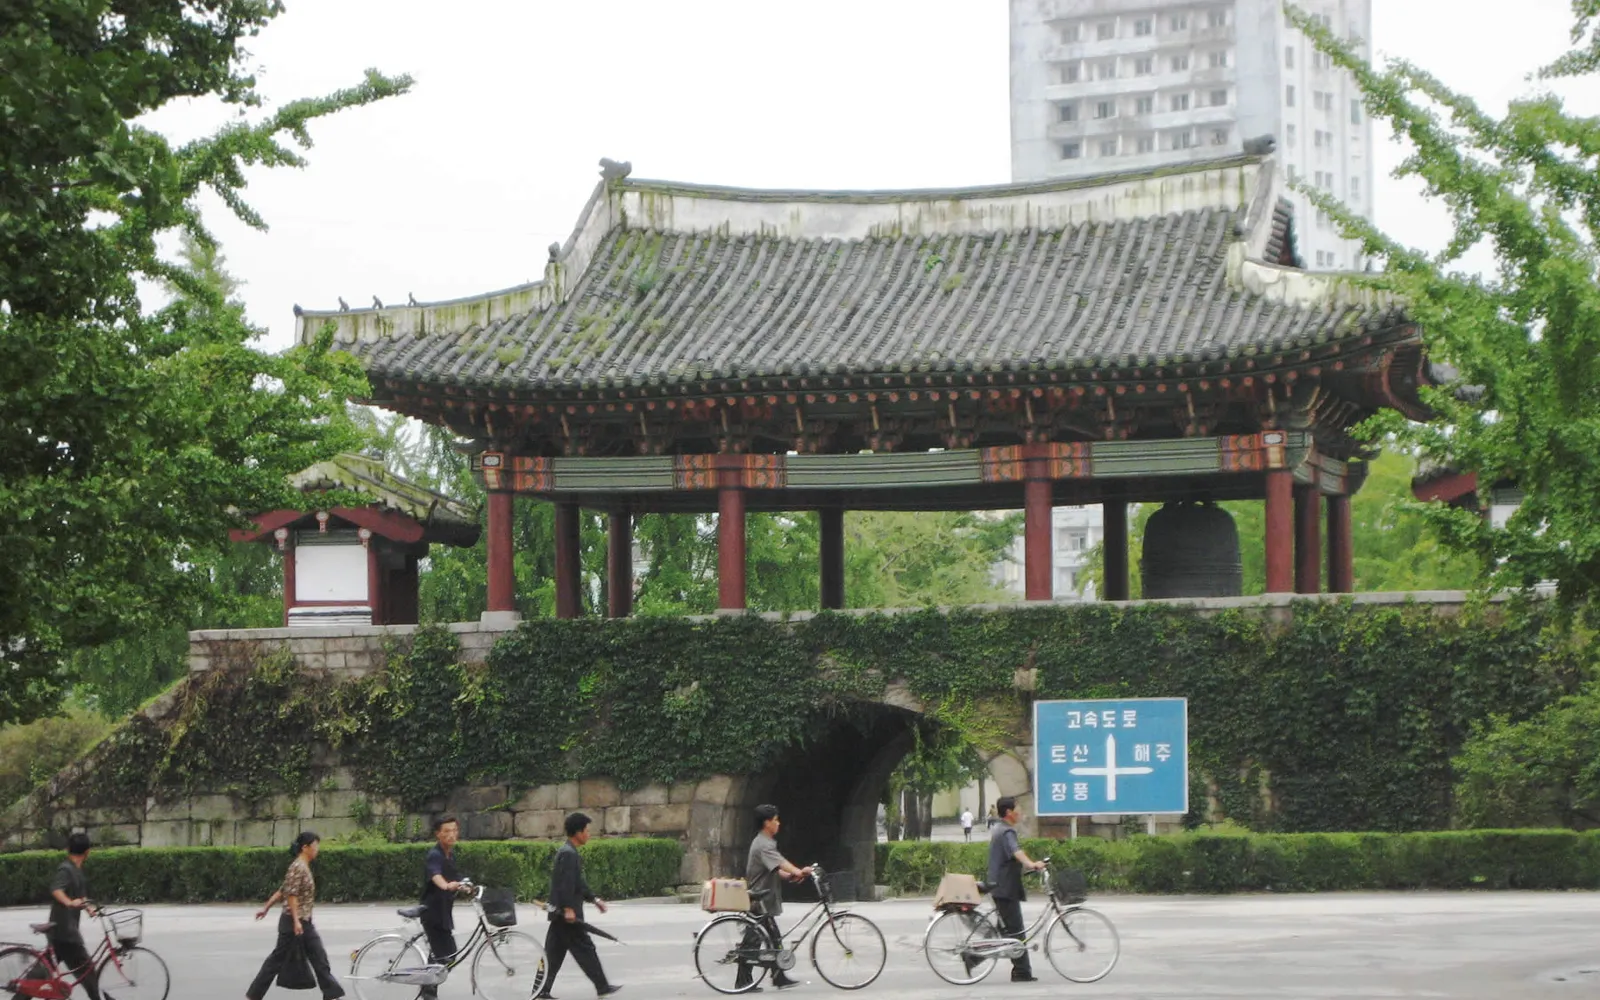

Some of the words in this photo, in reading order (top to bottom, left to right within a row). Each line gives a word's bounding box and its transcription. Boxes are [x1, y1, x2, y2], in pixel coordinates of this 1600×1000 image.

[1067, 710, 1137, 729] 고속도로
[1052, 744, 1089, 763] 토산
[1134, 744, 1171, 762] 해주
[1052, 782, 1089, 801] 장풍
